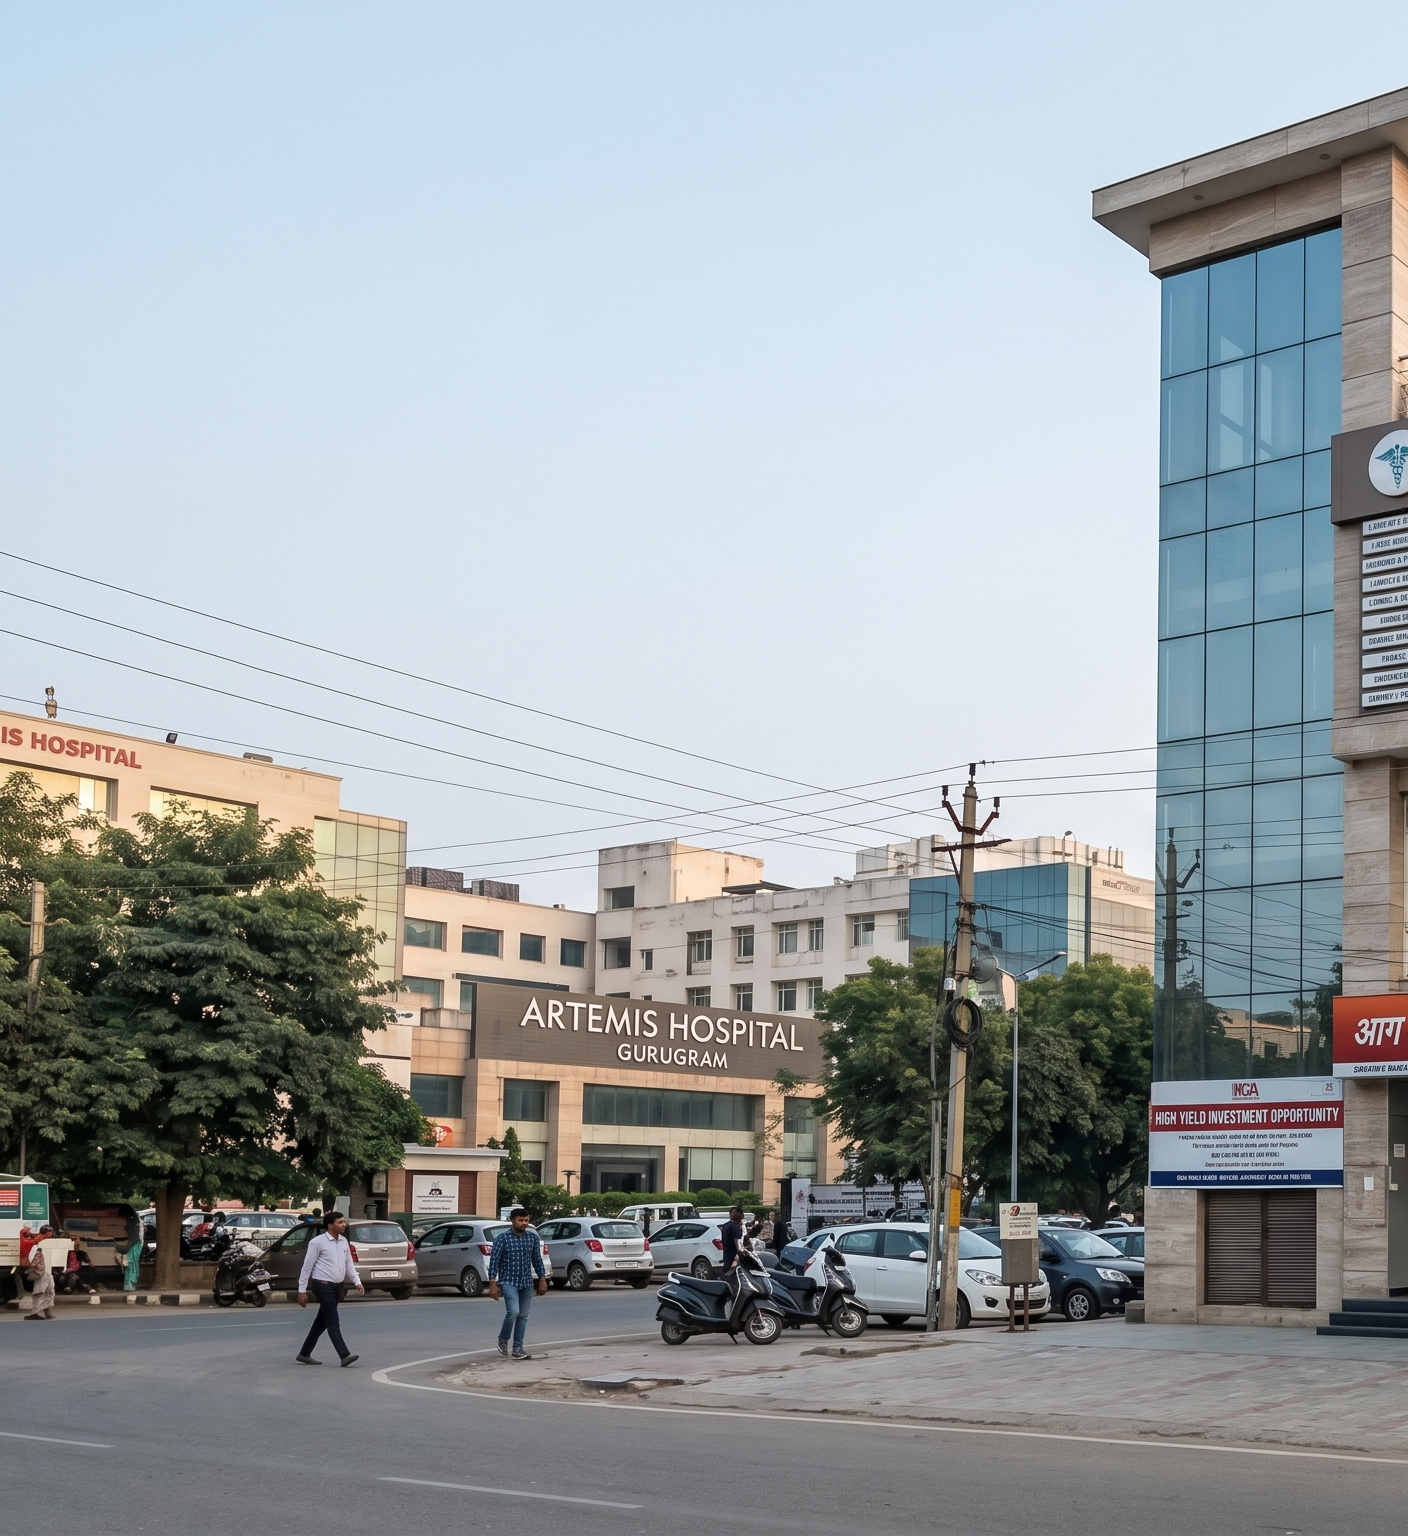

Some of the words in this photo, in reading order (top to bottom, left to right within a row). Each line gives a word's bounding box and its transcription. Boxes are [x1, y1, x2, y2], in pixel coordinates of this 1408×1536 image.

[31, 731, 142, 770] HOSPITAL
[519, 996, 658, 1038] ARTEMIS
[669, 1012, 804, 1052] HOSPITAL
[1354, 1017, 1406, 1046] आग
[617, 1043, 729, 1069] GURUGRAM
[1155, 1111, 1177, 1126] HIGH
[1179, 1110, 1206, 1125] YIELD
[1208, 1109, 1268, 1124] INVESTMENT
[1270, 1107, 1339, 1123] OPPORTUNITY
